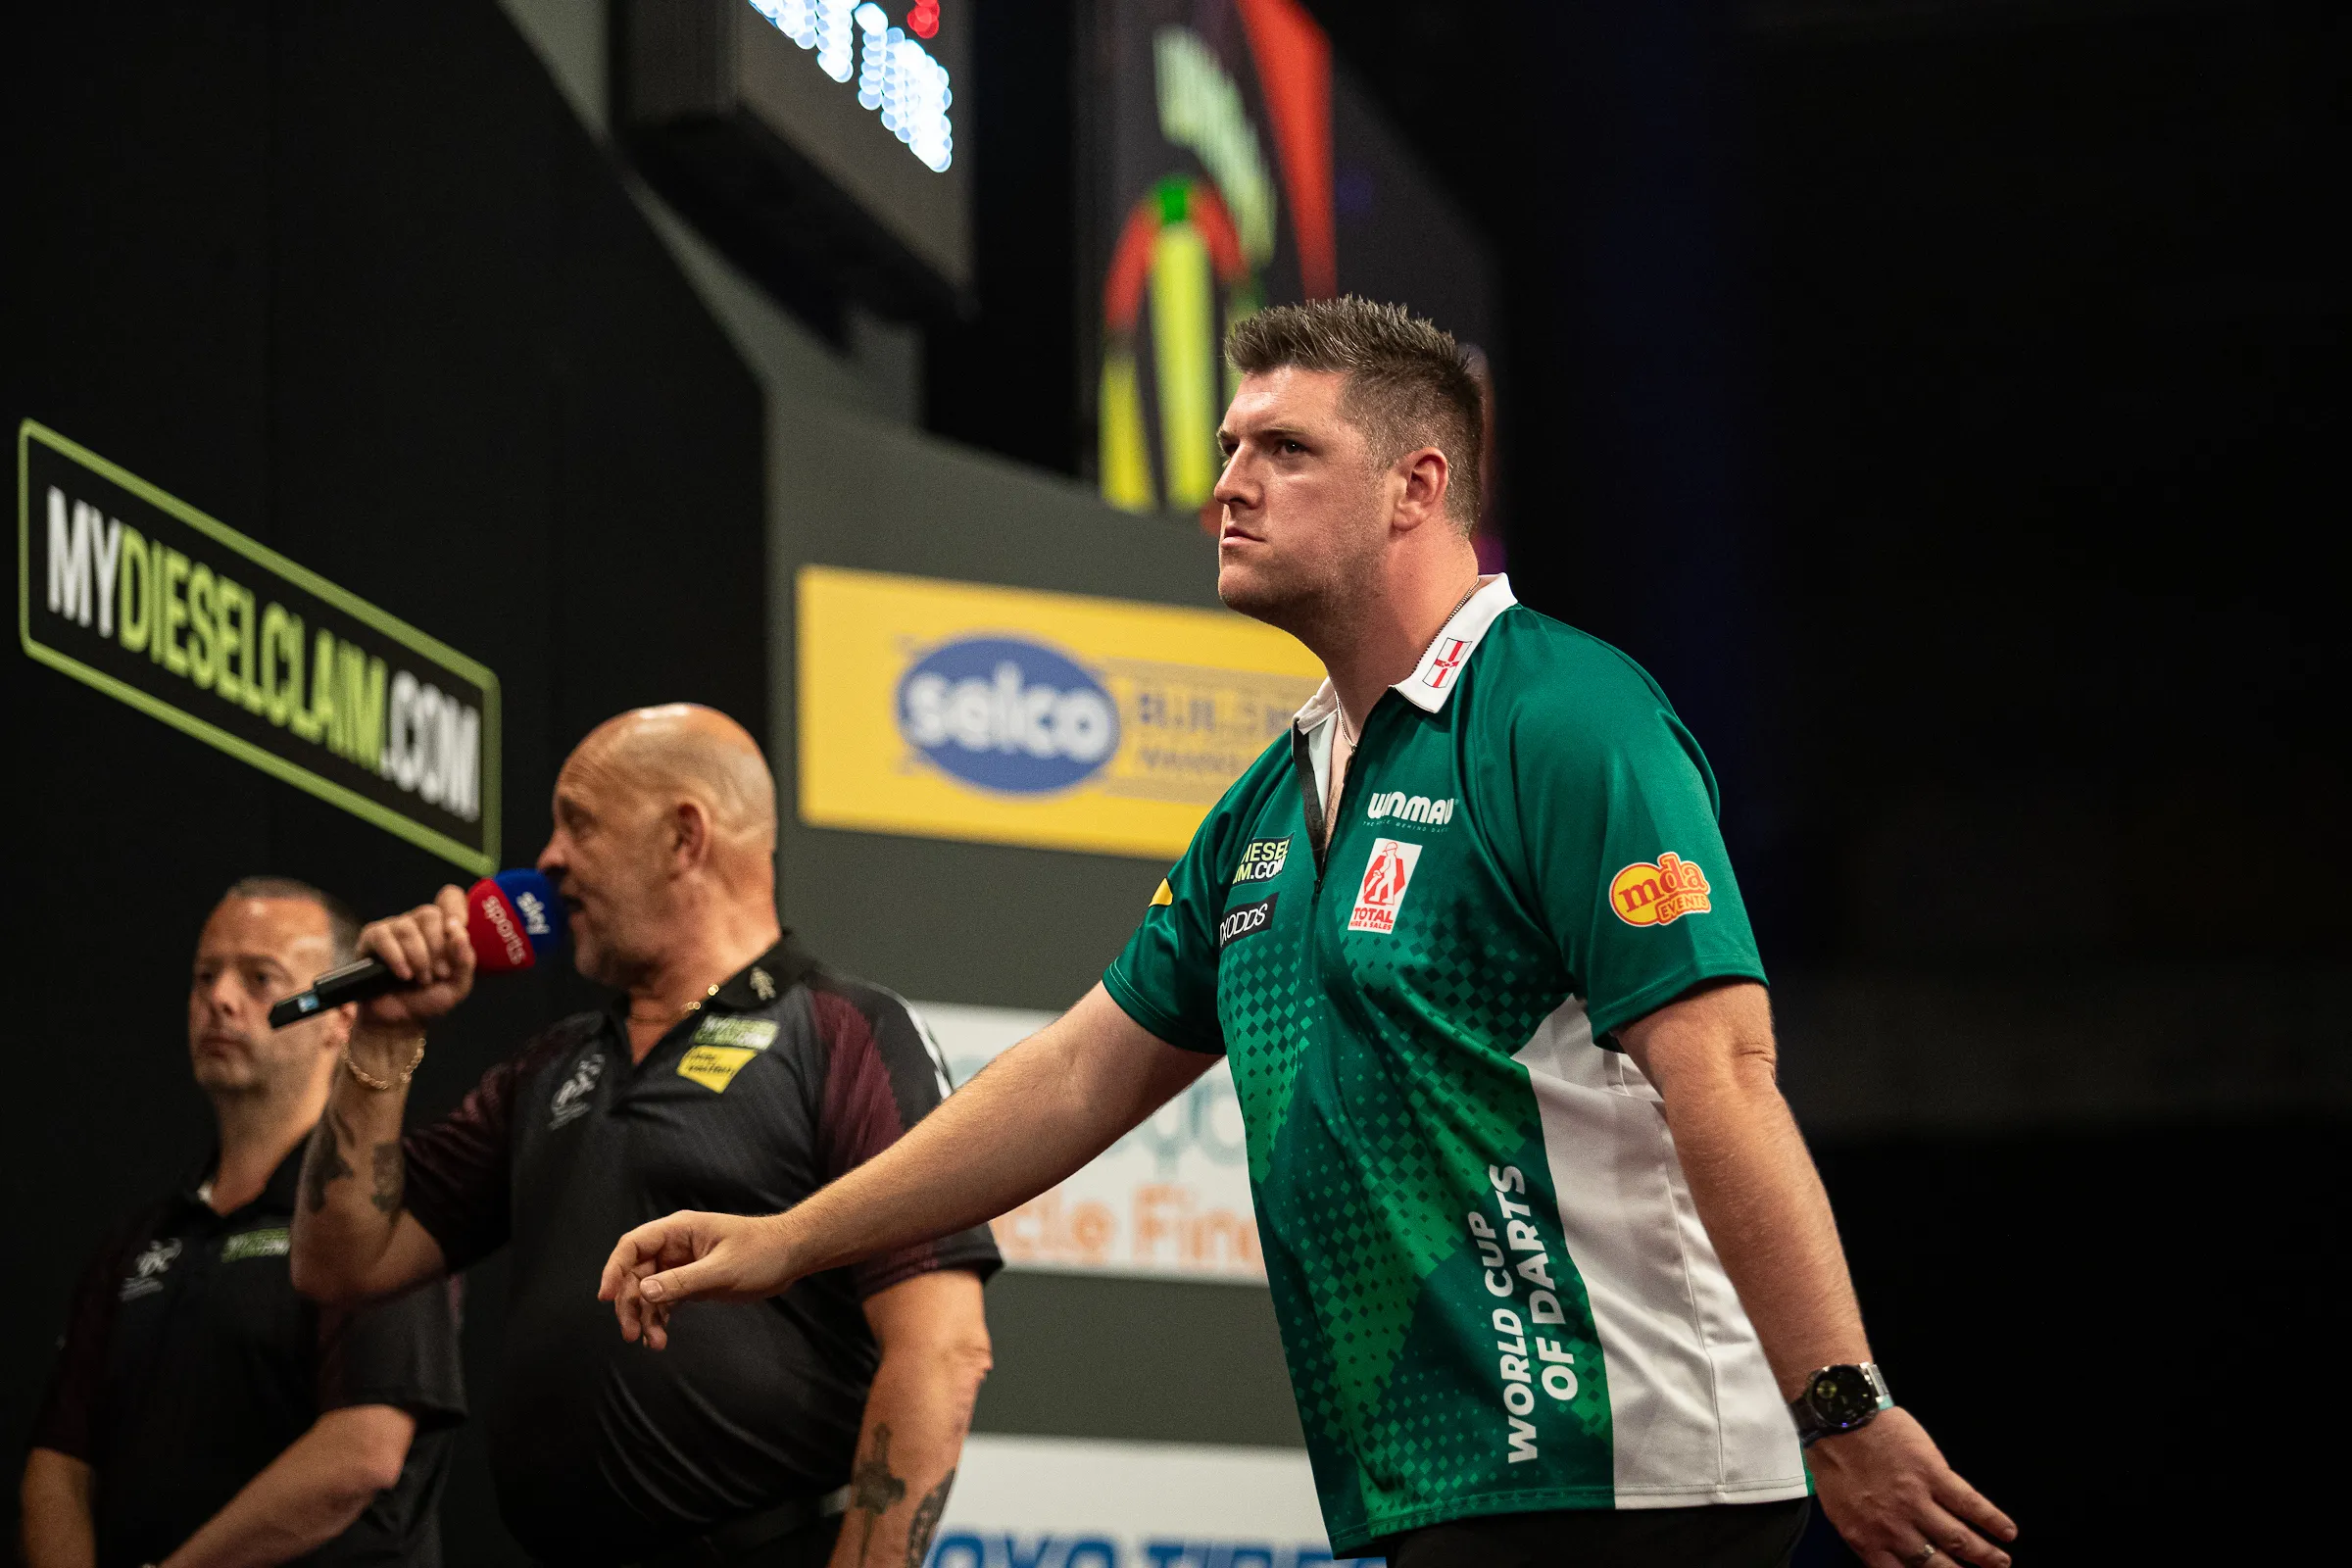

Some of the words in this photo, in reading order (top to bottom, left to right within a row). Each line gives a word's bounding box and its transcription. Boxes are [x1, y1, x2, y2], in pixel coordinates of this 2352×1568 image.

[47, 485, 480, 822] MYDIESELCLAIM.COM
[905, 662, 1116, 762] selco
[515, 891, 551, 935] sky
[1353, 907, 1394, 924] TOTAL
[1617, 854, 1708, 913] mda
[1660, 895, 1708, 919] EVENTS
[481, 895, 526, 965] sports
[1369, 921, 1393, 931] SALES
[1468, 1210, 1514, 1297] CUP
[1489, 1163, 1567, 1325] DARTS
[1492, 1308, 1538, 1464] WORLD
[1537, 1336, 1579, 1401] OF
